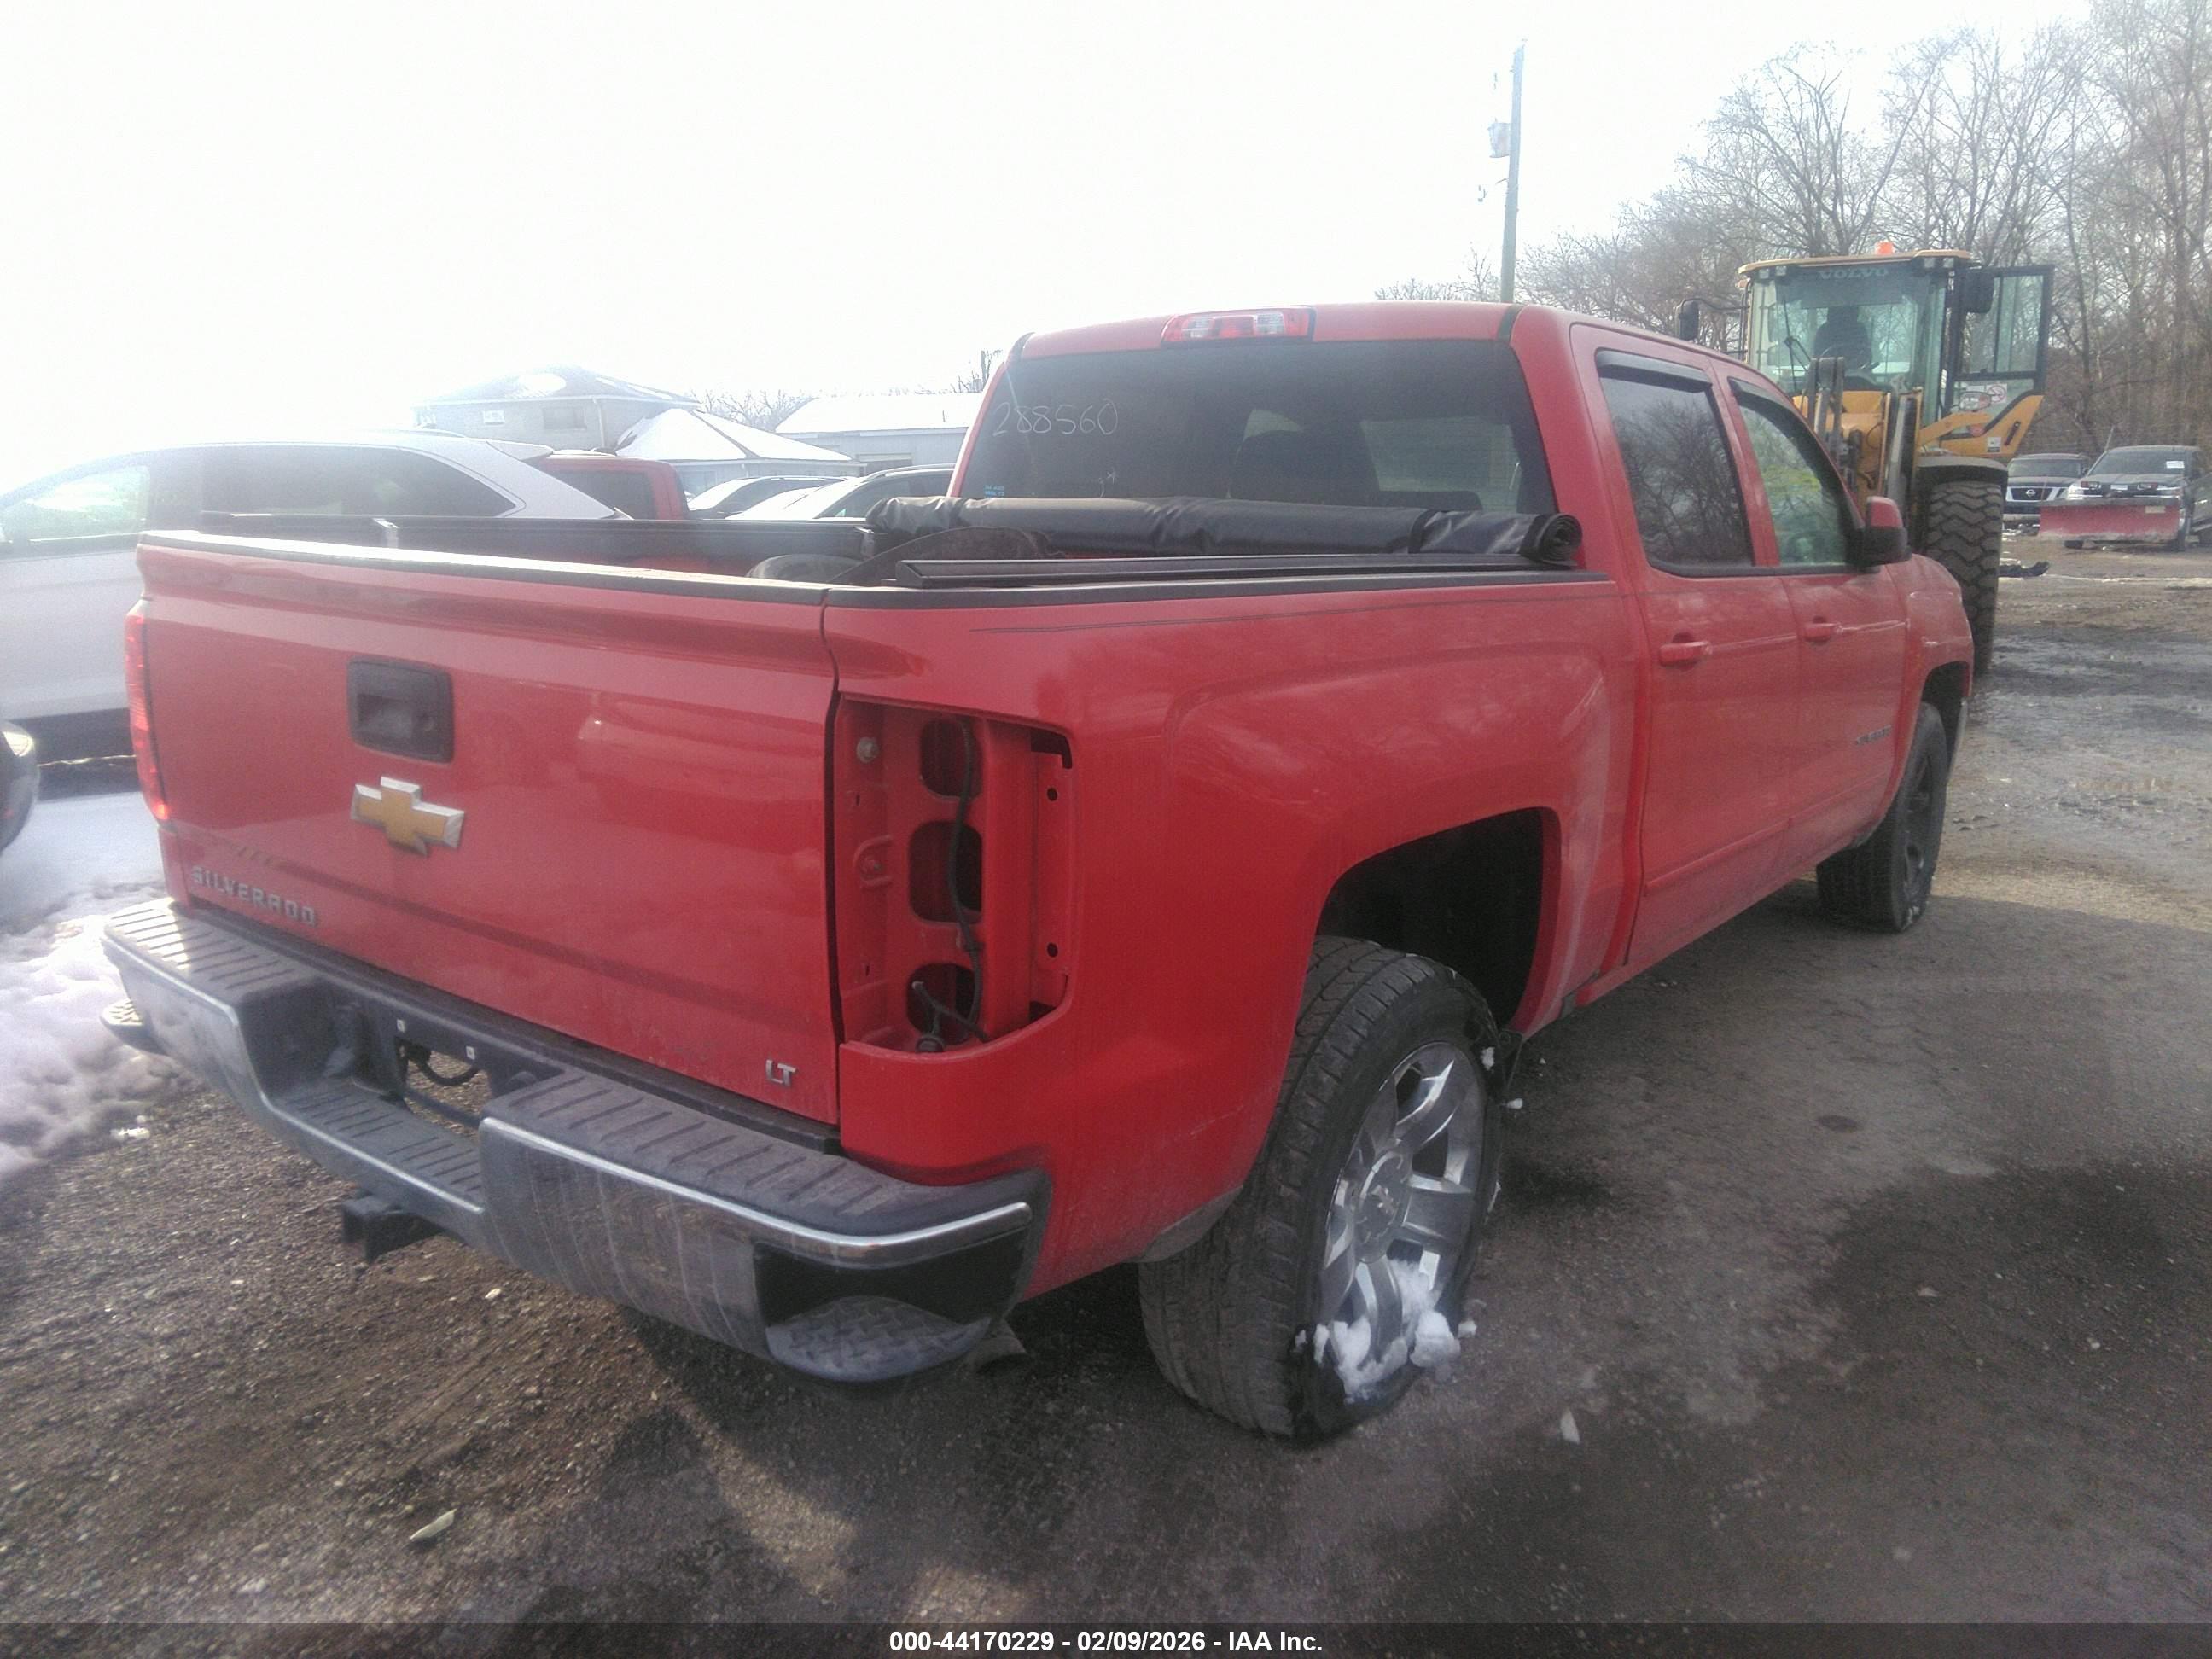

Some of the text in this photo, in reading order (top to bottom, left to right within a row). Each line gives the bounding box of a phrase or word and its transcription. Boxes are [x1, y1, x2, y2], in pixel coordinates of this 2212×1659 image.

[1819, 267, 1889, 280] VOLVO
[992, 399, 1118, 437] 288560
[191, 864, 318, 927] SILVERADO
[765, 1059, 797, 1086] LT
